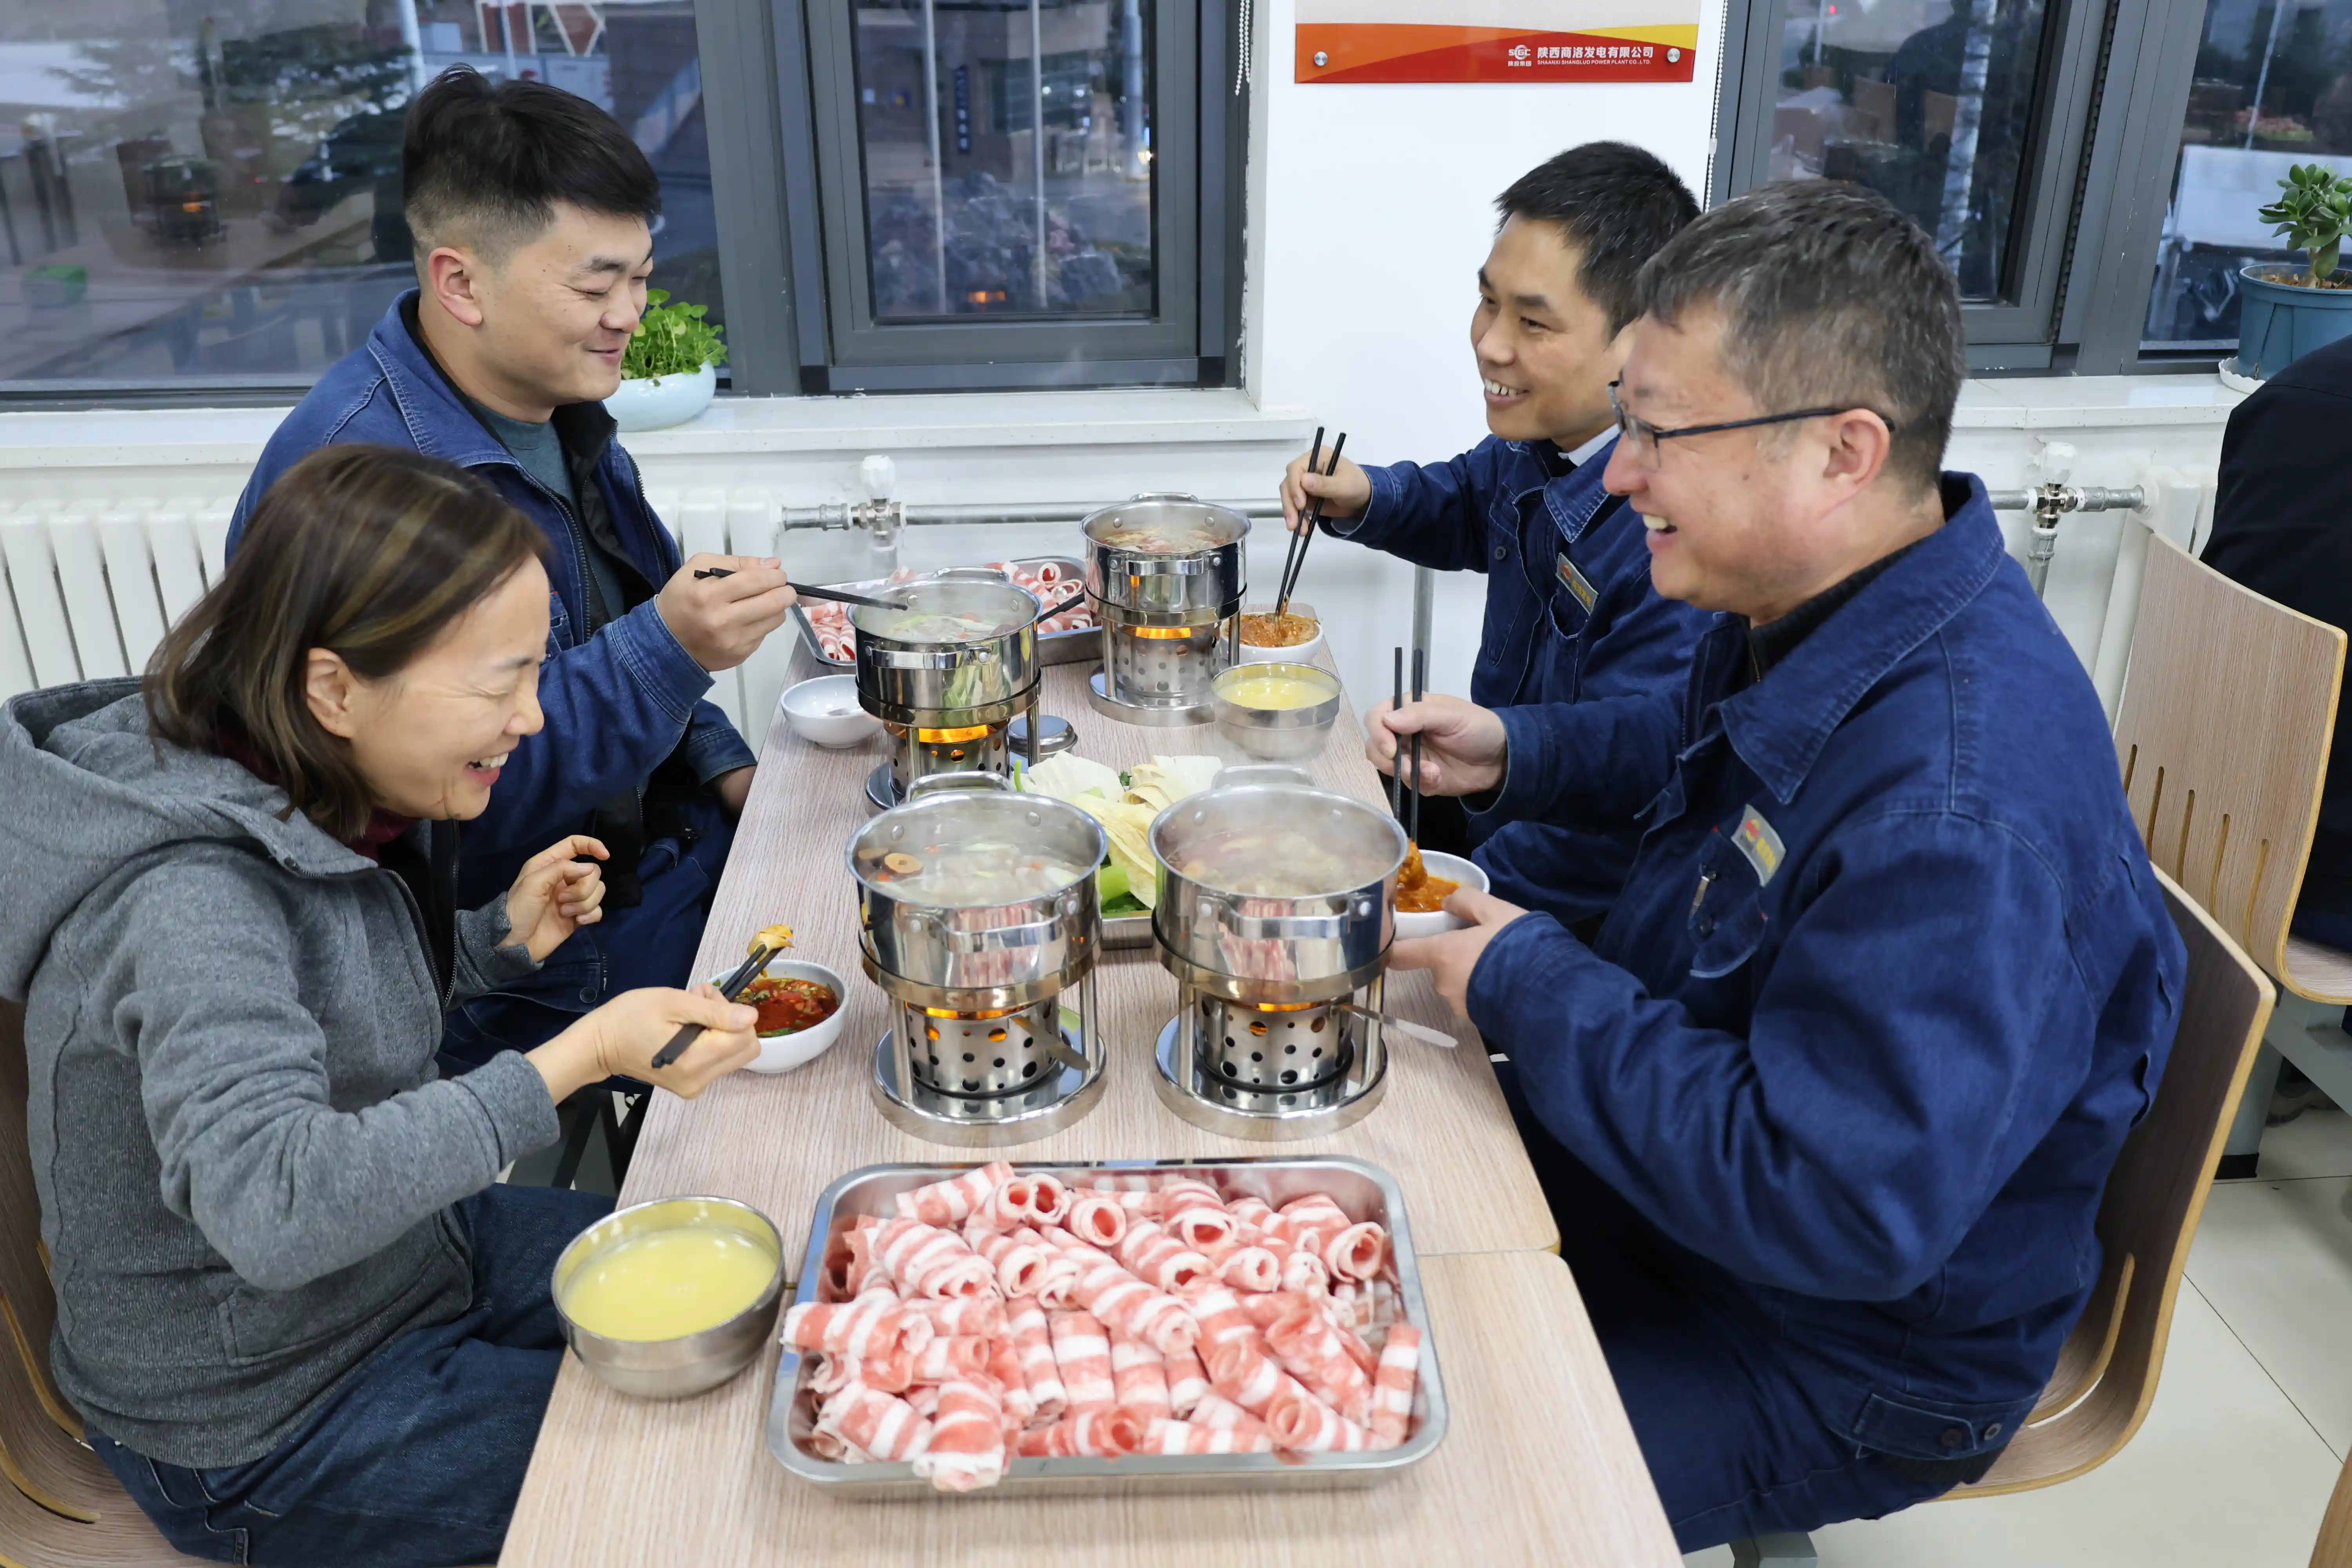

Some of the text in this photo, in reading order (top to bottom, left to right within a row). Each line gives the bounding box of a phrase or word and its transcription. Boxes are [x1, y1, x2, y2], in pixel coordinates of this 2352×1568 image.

[1537, 47, 1653, 58] 陕西商洛发电有限公司
